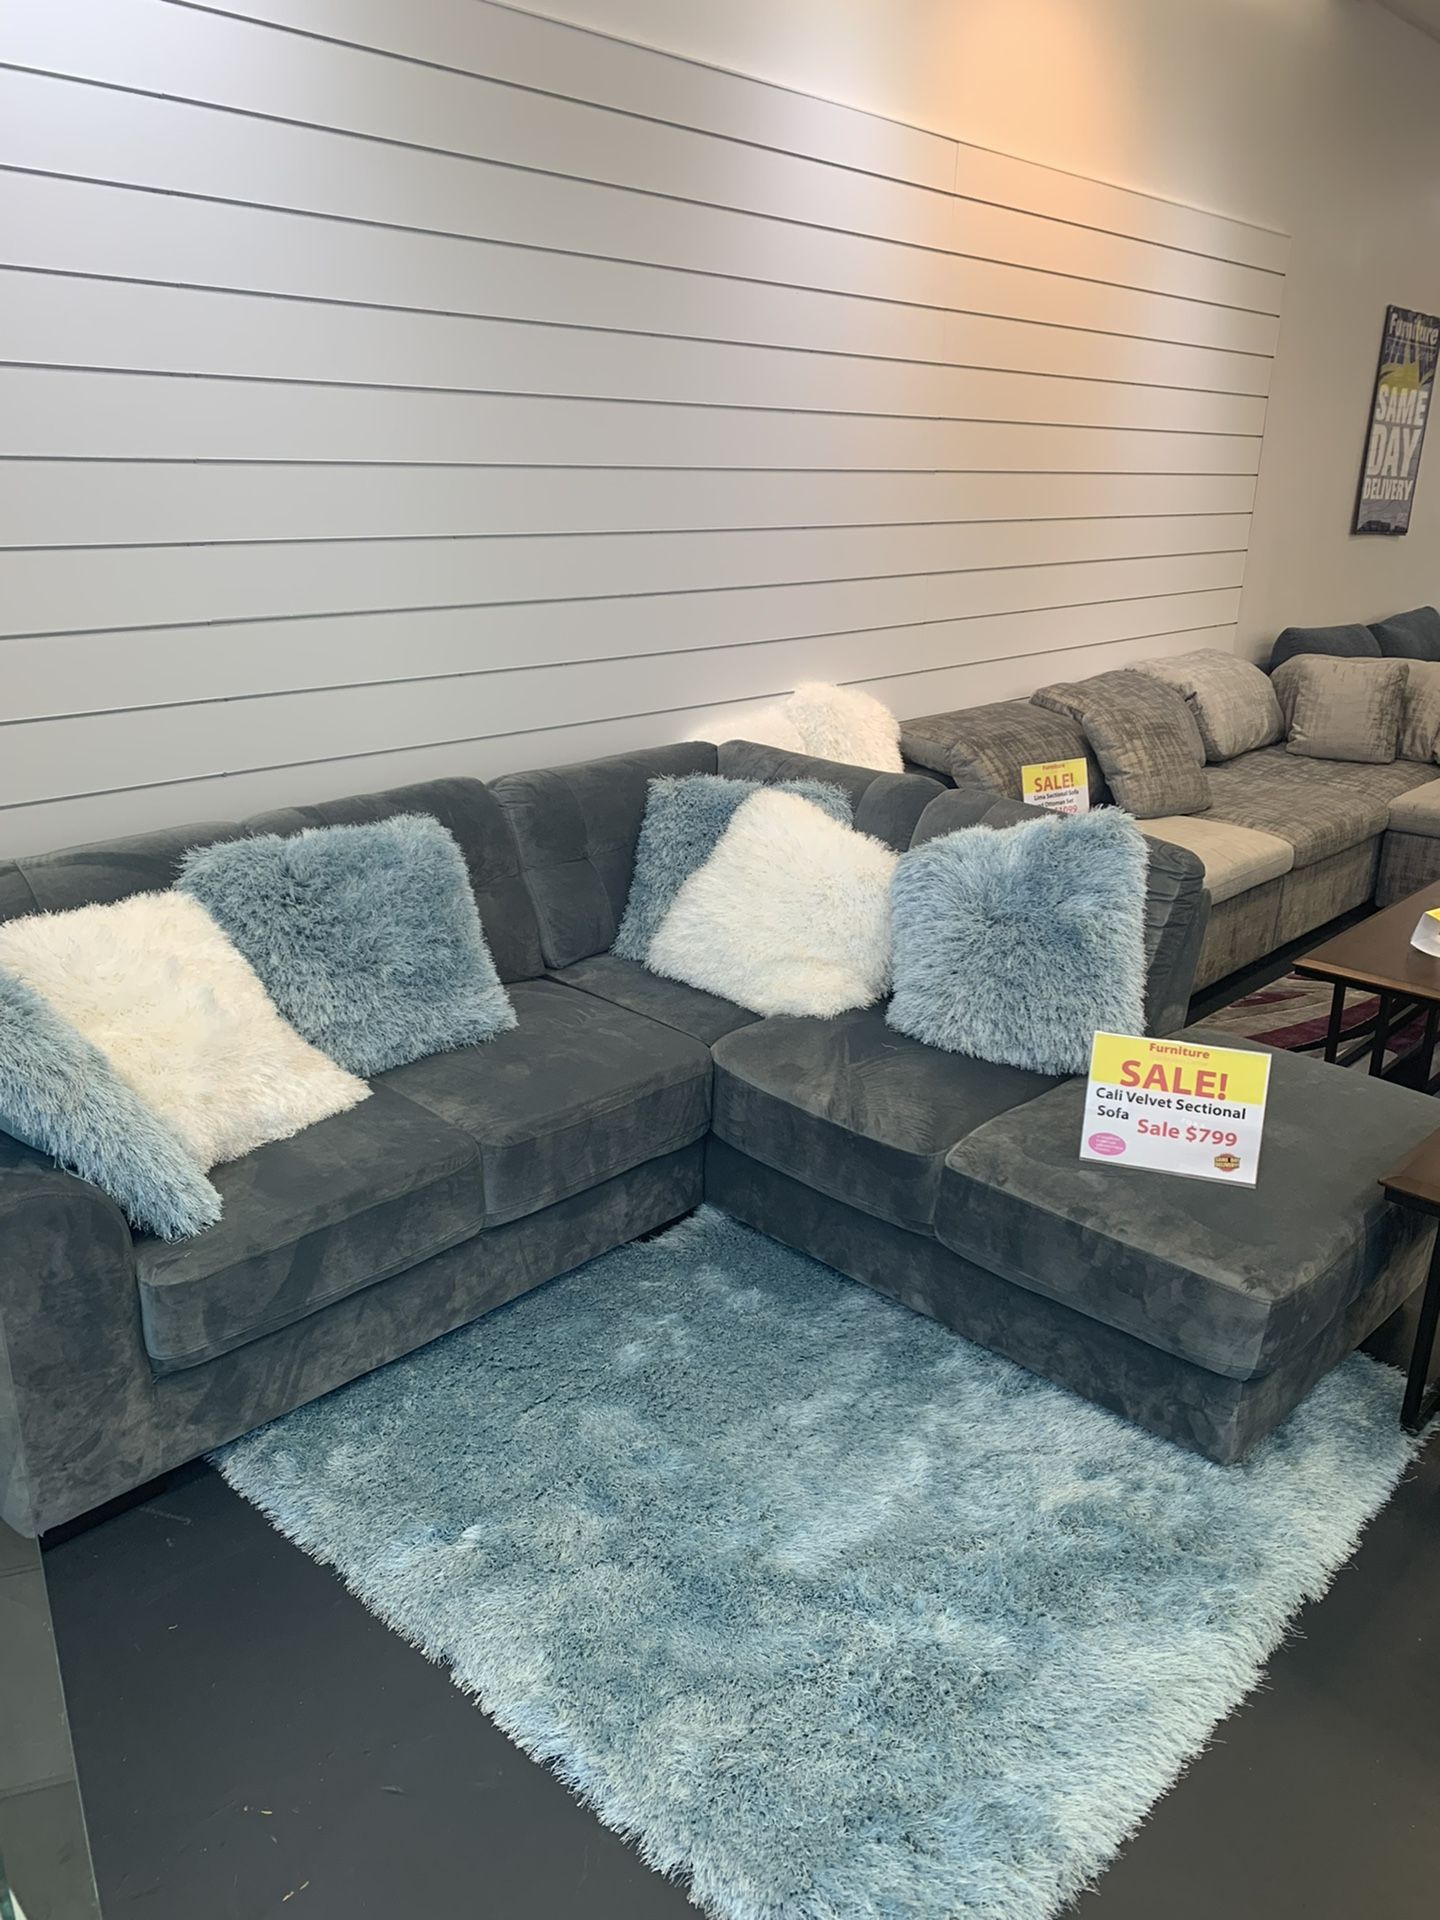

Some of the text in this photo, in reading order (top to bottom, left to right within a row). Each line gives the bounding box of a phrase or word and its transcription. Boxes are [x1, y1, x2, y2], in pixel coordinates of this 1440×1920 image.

[1389, 313, 1439, 345] Furniture
[1375, 383, 1428, 425] SAME
[1366, 423, 1422, 478] DAY
[1362, 477, 1413, 501] DELIVERY
[1034, 772, 1075, 793] SALE!
[1046, 791, 1068, 799] Sectional
[1149, 1042, 1210, 1059] Furniture
[1119, 1059, 1229, 1101] SALE!
[1096, 1087, 1247, 1120] Cali Velvet Sectional
[1097, 1105, 1130, 1120] Sofa
[1137, 1118, 1180, 1139] Sale
[1185, 1125, 1238, 1147] $799
